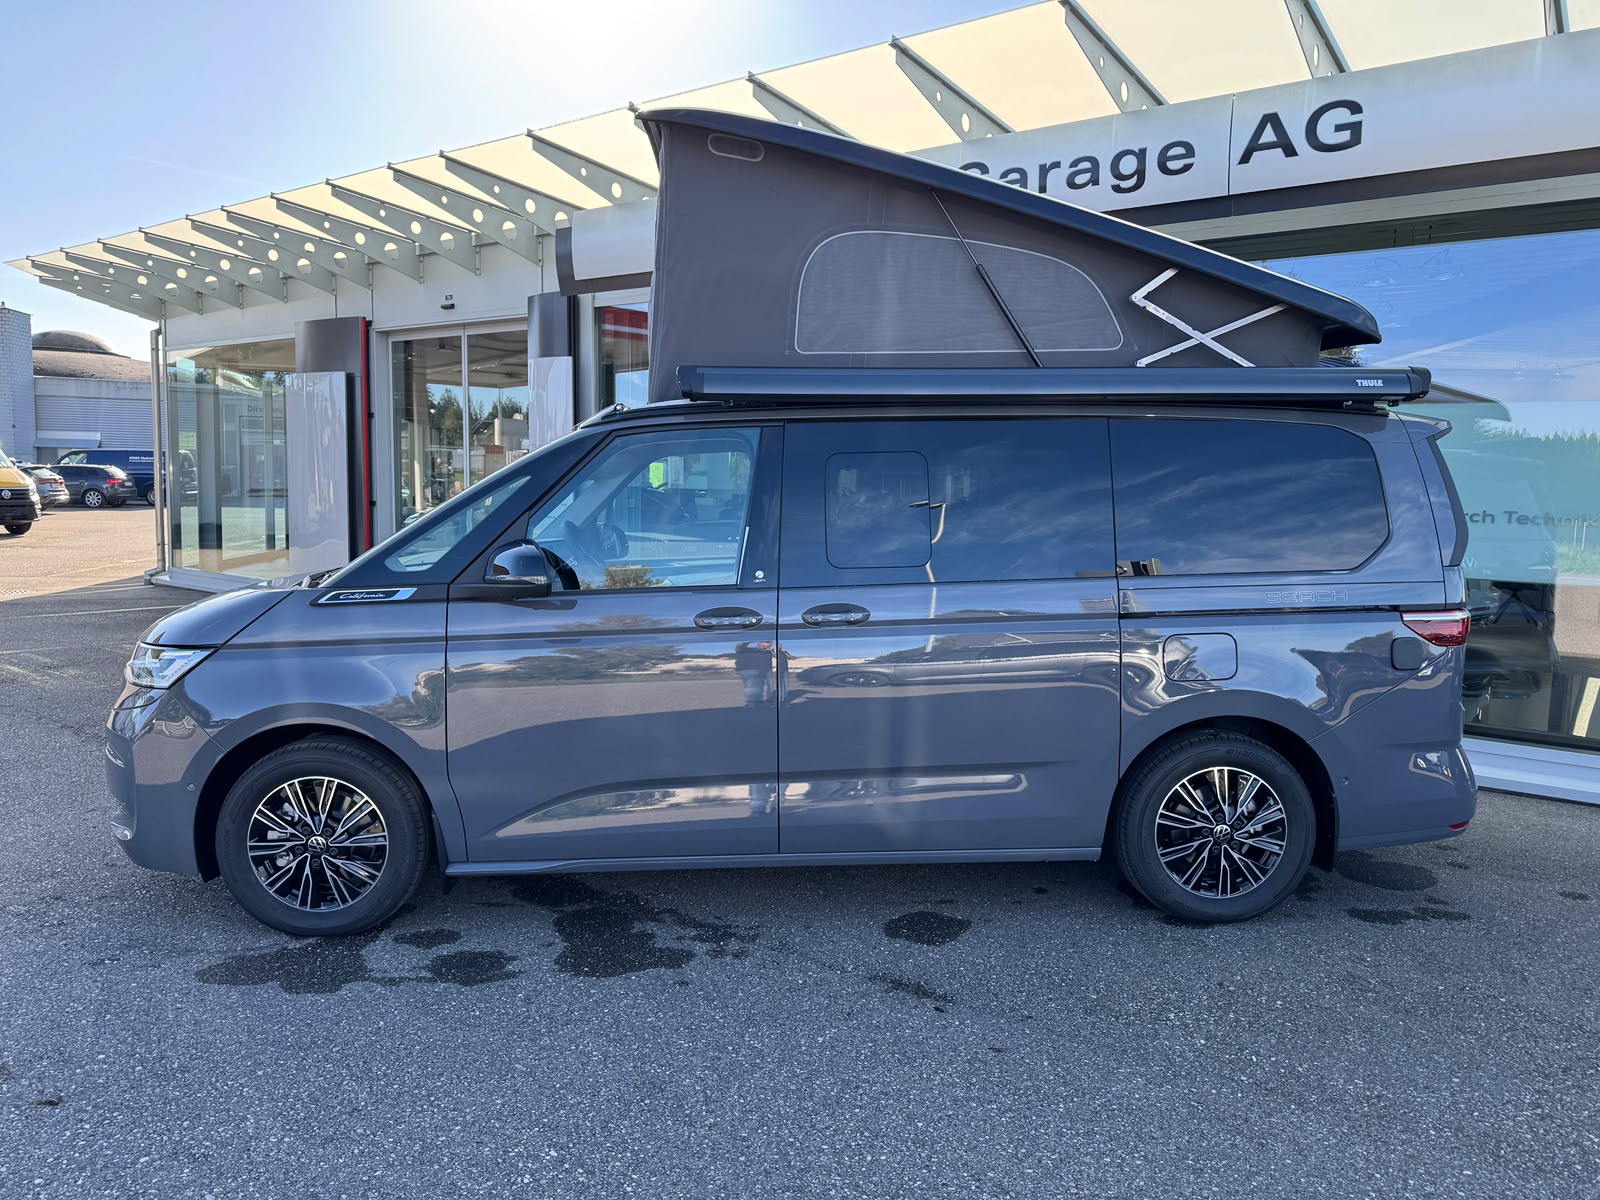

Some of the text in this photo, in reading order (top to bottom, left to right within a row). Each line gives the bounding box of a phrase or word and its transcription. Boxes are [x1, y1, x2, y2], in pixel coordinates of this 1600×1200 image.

[1237, 99, 1364, 166] AG
[1356, 379, 1384, 387] THULE
[339, 592, 386, 600] California
[1265, 590, 1349, 604] BEACH
